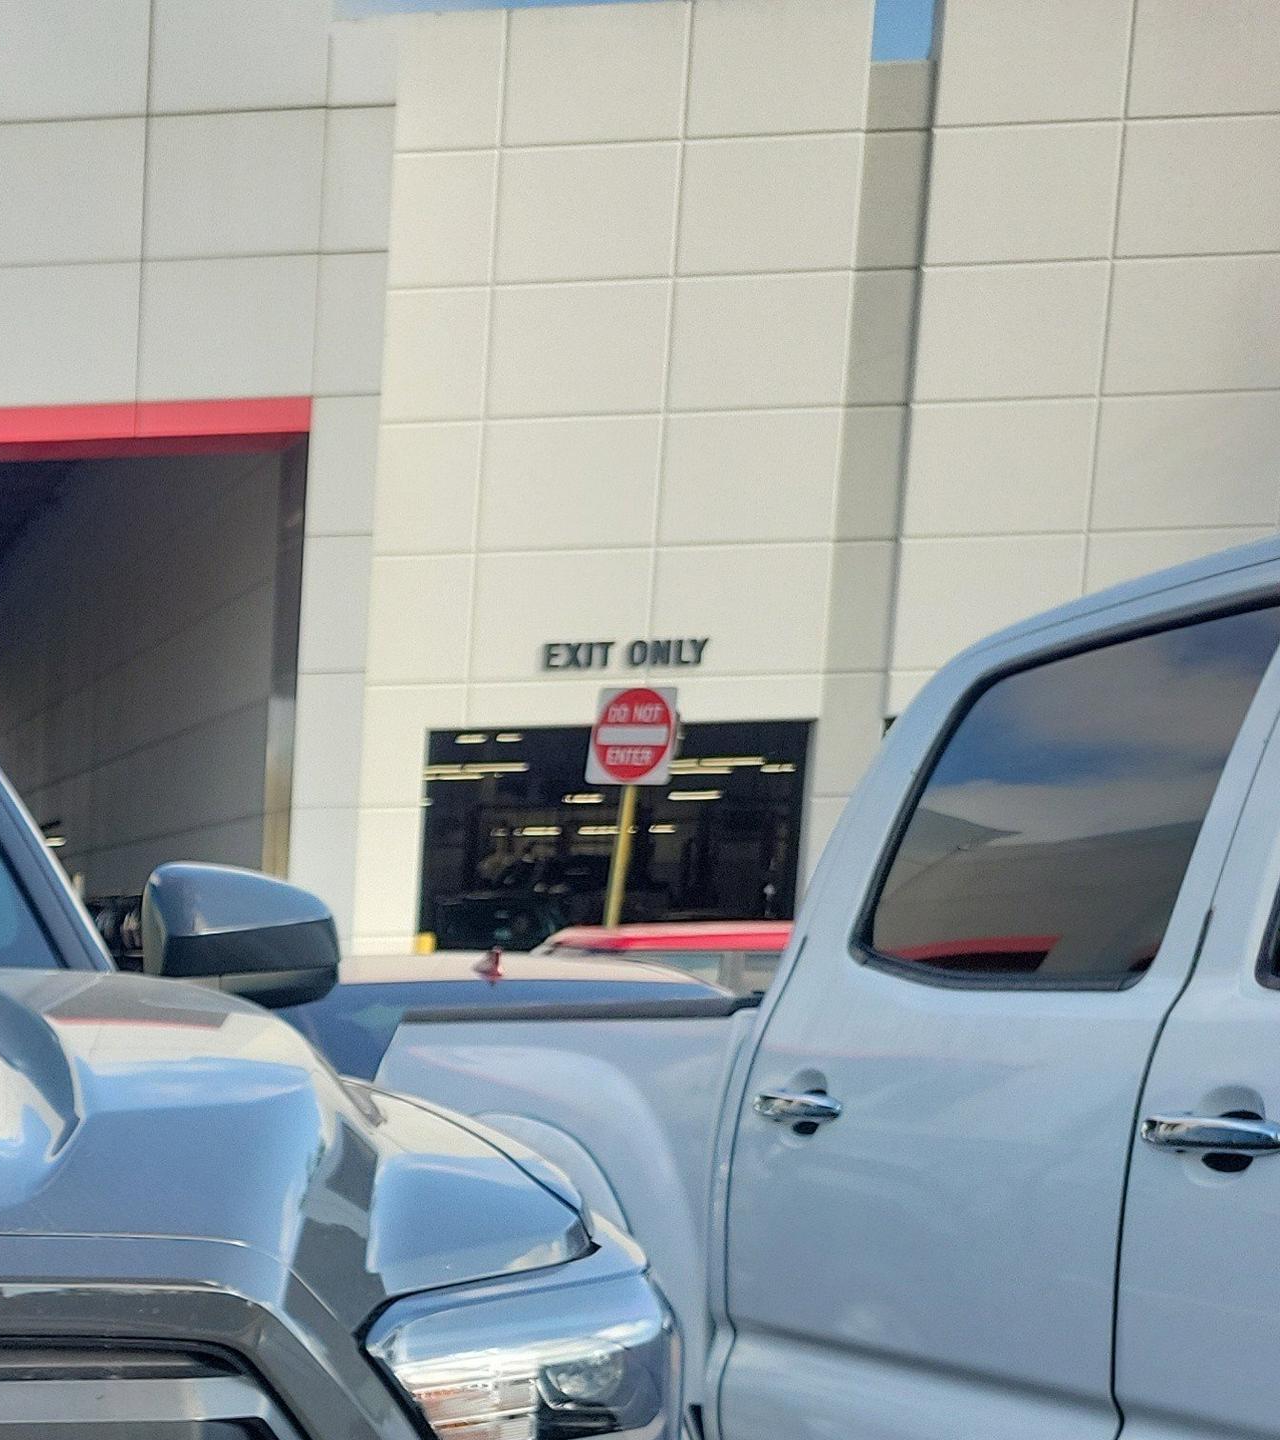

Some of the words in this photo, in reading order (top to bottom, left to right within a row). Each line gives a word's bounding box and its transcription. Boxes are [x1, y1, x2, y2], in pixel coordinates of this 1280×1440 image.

[544, 641, 614, 668] EXIT
[628, 638, 709, 666] ONLY
[608, 705, 629, 722] DO
[633, 703, 664, 722] NOT
[606, 746, 653, 766] ENTER
